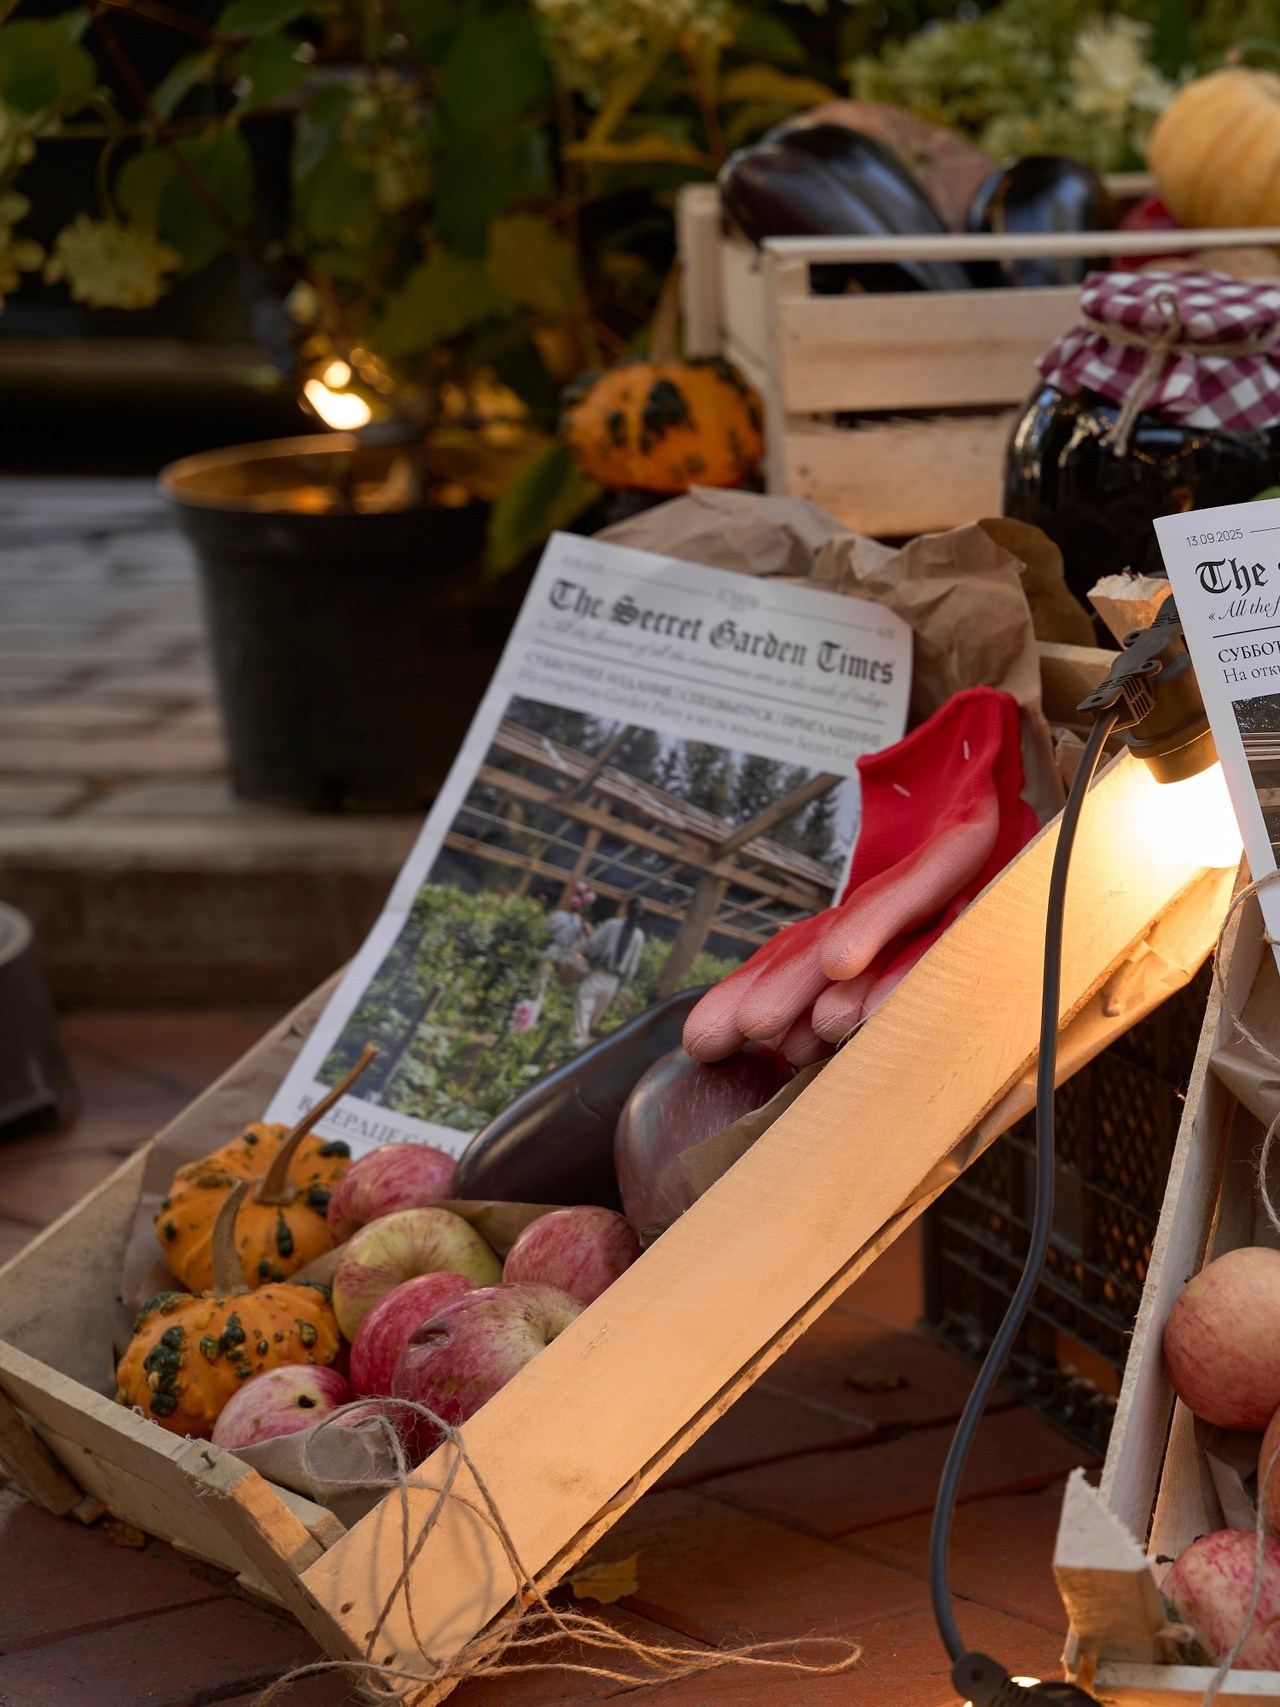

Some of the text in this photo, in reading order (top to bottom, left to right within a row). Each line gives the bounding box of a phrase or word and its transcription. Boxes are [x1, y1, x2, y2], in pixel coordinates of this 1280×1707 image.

[1186, 528, 1244, 547] 13.09.2025
[1195, 558, 1269, 597] The
[1249, 596, 1272, 615] the
[548, 577, 604, 621] The
[609, 594, 703, 643] Secret
[708, 618, 808, 668] Garden
[816, 639, 897, 686] Times
[1222, 667, 1248, 684] На
[325, 1106, 400, 1143] ЕРДЦЕ
